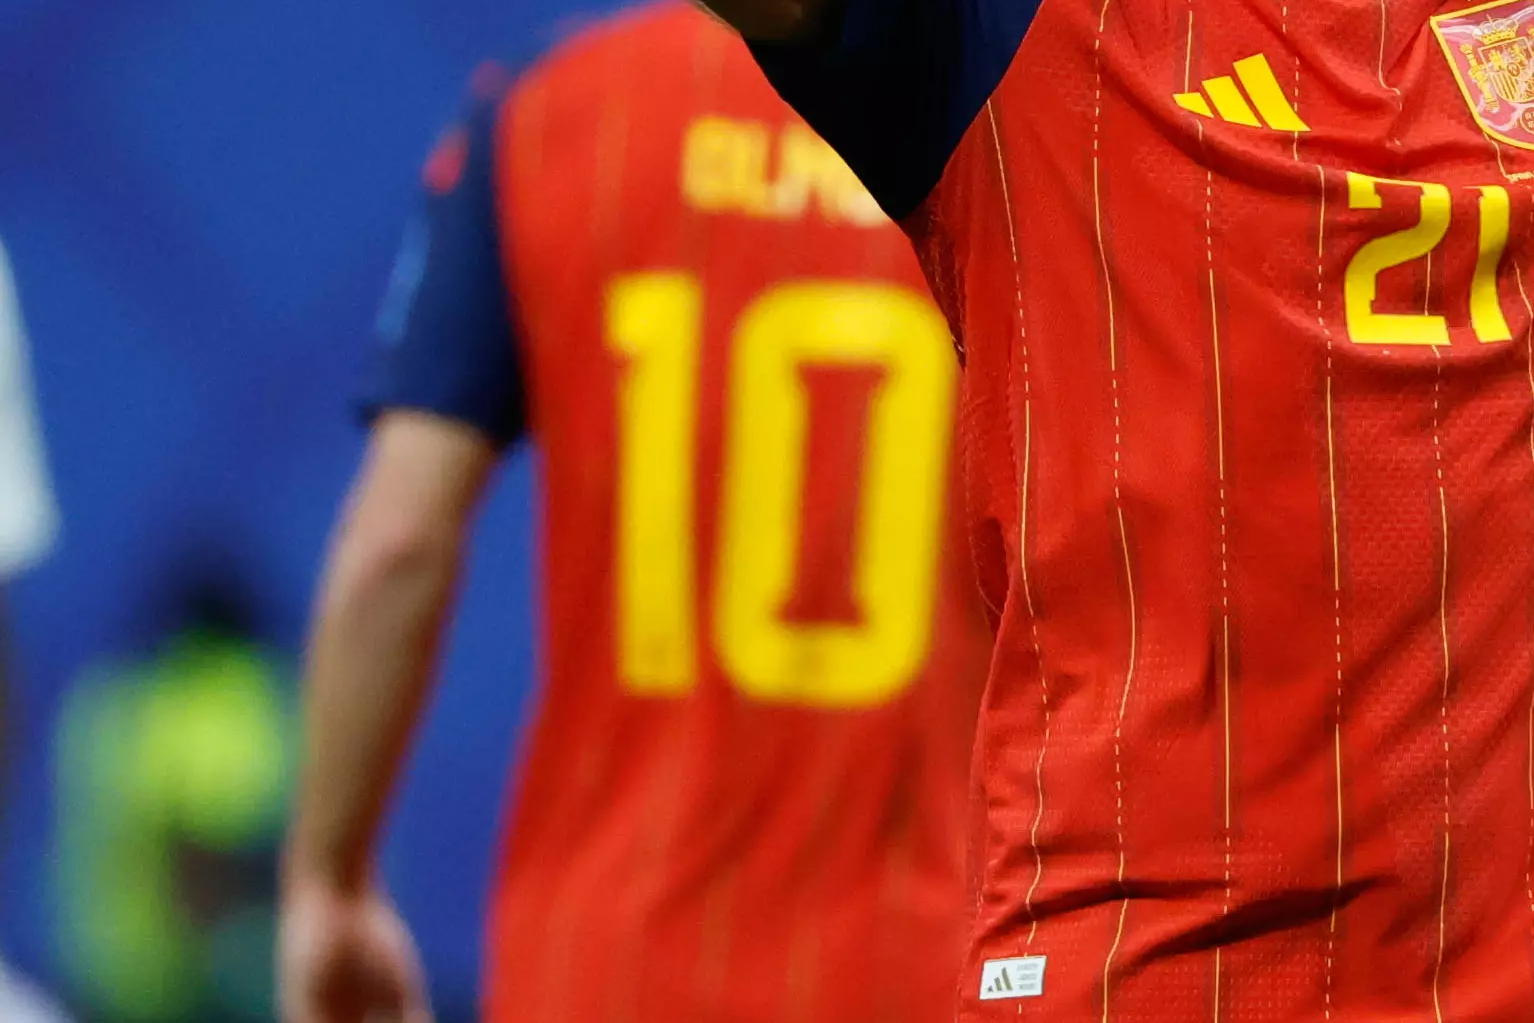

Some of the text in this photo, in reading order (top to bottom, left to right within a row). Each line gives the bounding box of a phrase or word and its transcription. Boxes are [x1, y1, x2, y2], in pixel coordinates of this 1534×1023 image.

[683, 116, 892, 228] OLM
[1344, 172, 1513, 346] 21
[606, 274, 958, 707] 10
